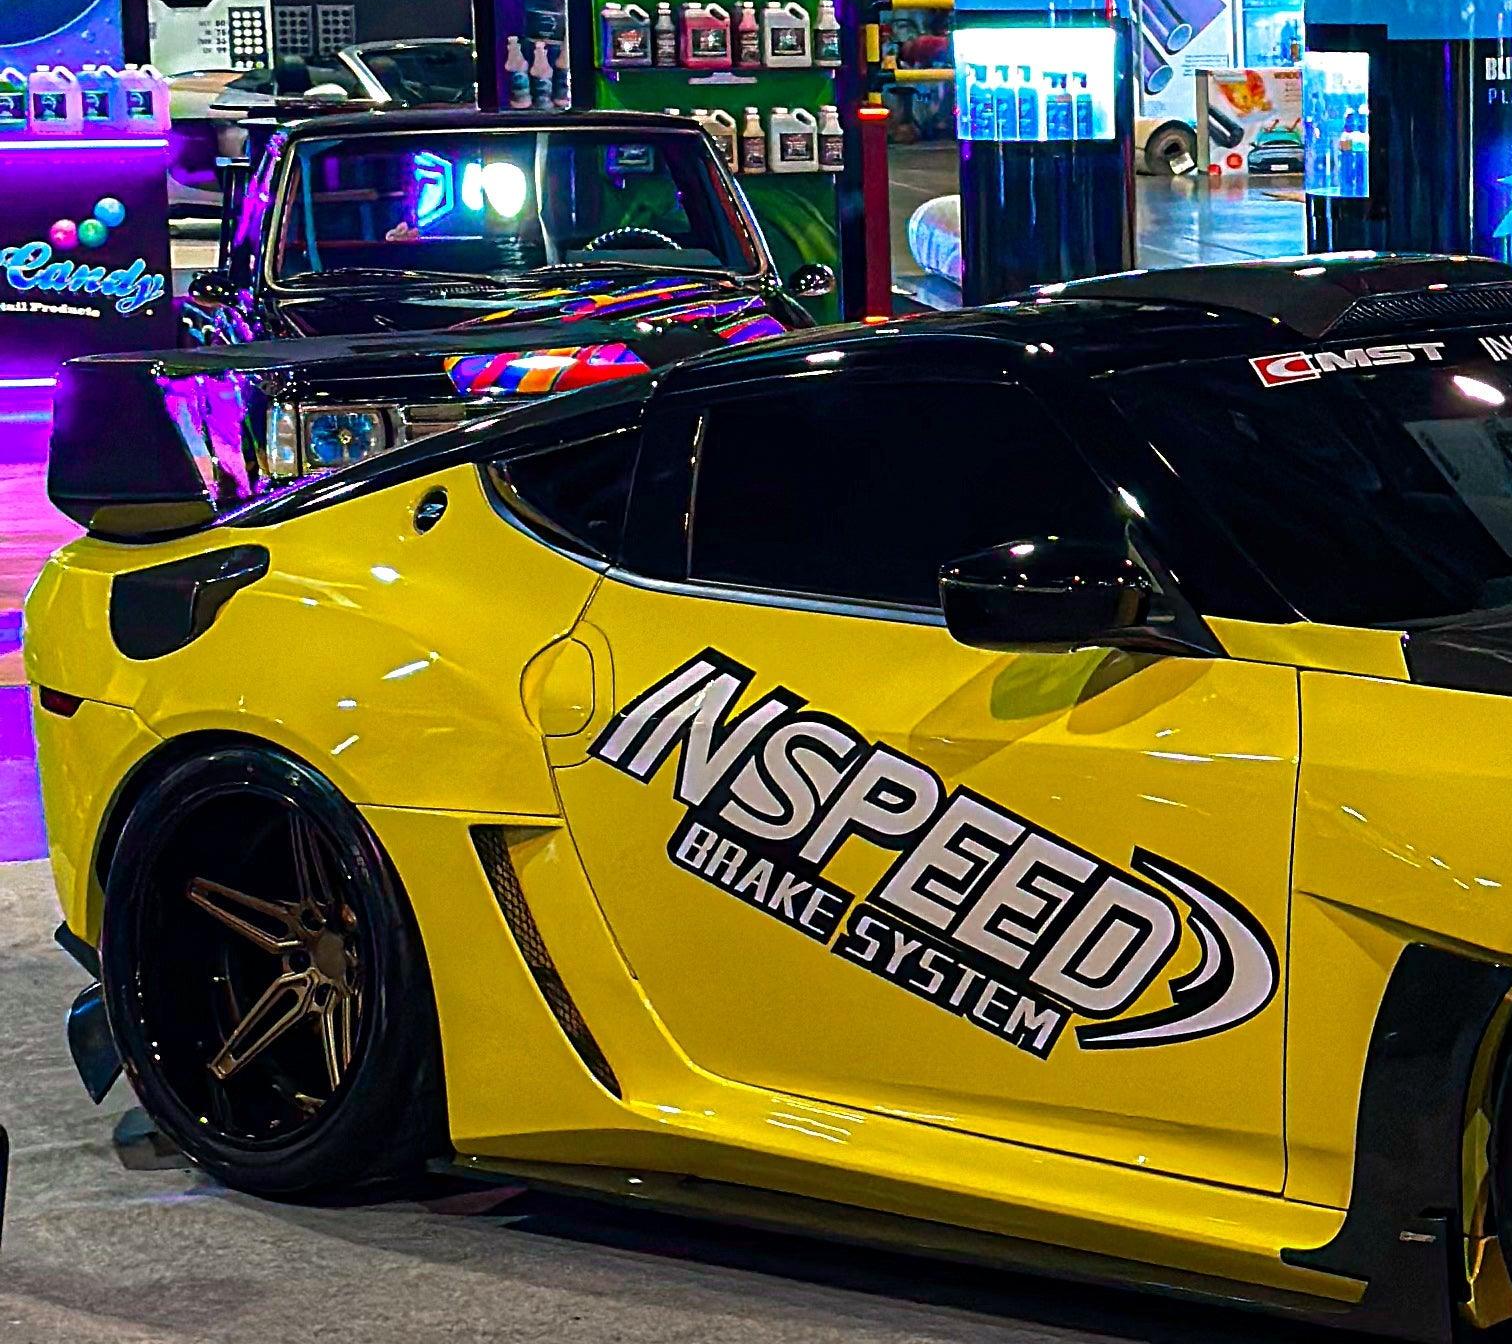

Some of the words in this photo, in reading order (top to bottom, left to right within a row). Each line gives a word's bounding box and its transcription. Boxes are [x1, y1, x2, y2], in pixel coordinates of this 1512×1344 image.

[30, 302, 101, 318] Products
[596, 656, 1181, 1014] INSPEED
[676, 820, 844, 937] BRAKE
[843, 915, 1063, 1053] SYSTEM
